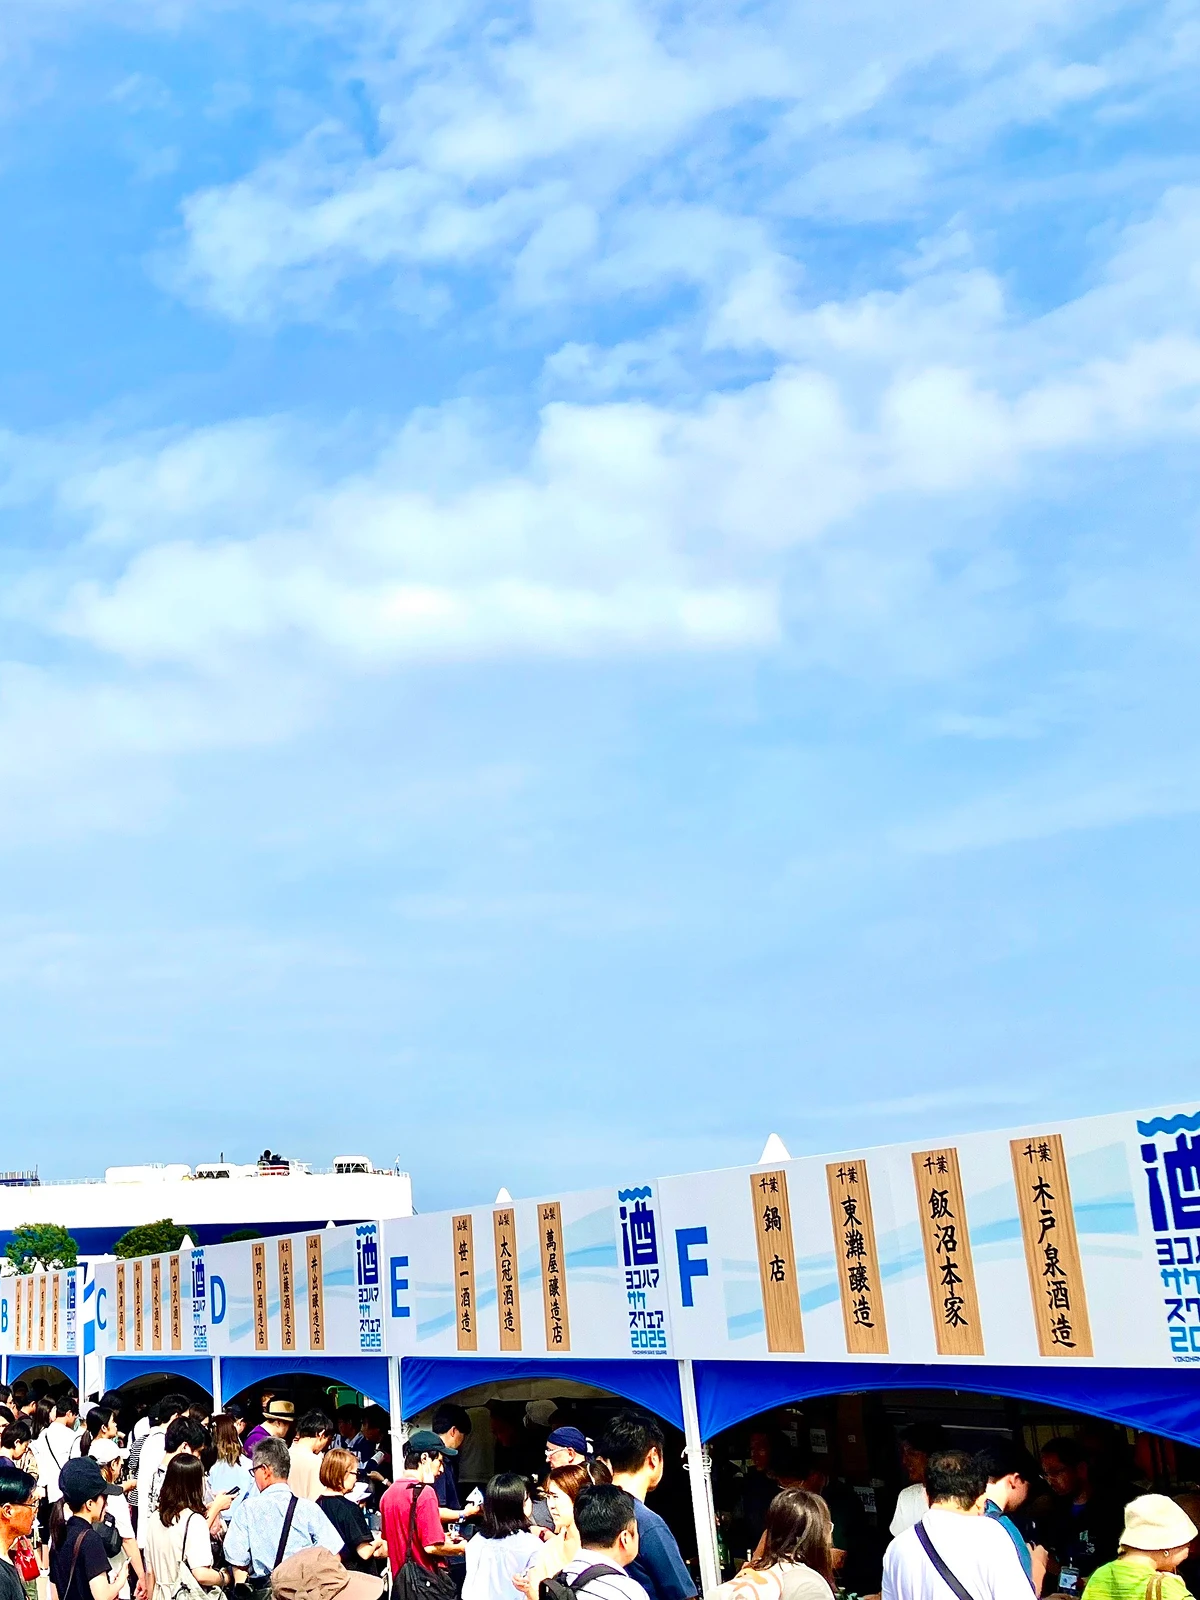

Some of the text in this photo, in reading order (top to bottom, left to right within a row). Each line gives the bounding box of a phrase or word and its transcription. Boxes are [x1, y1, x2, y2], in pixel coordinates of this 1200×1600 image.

[922, 1155, 949, 1175] 千葉
[1022, 1141, 1053, 1164] 千葉
[758, 1176, 779, 1194] 千葉
[835, 1166, 859, 1185] 千葉
[619, 1200, 659, 1267] 酒
[762, 1205, 786, 1283] 鍋店
[928, 1187, 969, 1328] 飯沼本家
[1031, 1175, 1078, 1349] 木戸泉酒造
[1155, 1236, 1200, 1266] ヨコ
[625, 1269, 660, 1290] ヨコハマ
[675, 1226, 709, 1308] F
[358, 1287, 379, 1303] ヨコハマ
[390, 1255, 411, 1317] E
[458, 1239, 472, 1333] 笹一酒造
[499, 1235, 516, 1333] 太冠酒造
[545, 1228, 563, 1344] 萬屋醸造店
[96, 1287, 107, 1331] C
[210, 1275, 227, 1325] D
[627, 1291, 646, 1310] サケ
[1164, 1298, 1200, 1324] スク
[1, 1299, 9, 1333] B
[359, 1319, 381, 1333] スクエア
[628, 1311, 664, 1329] スクエア
[360, 1334, 382, 1348] 2025
[630, 1330, 667, 1348] 2025
[1169, 1326, 1200, 1353] 20
